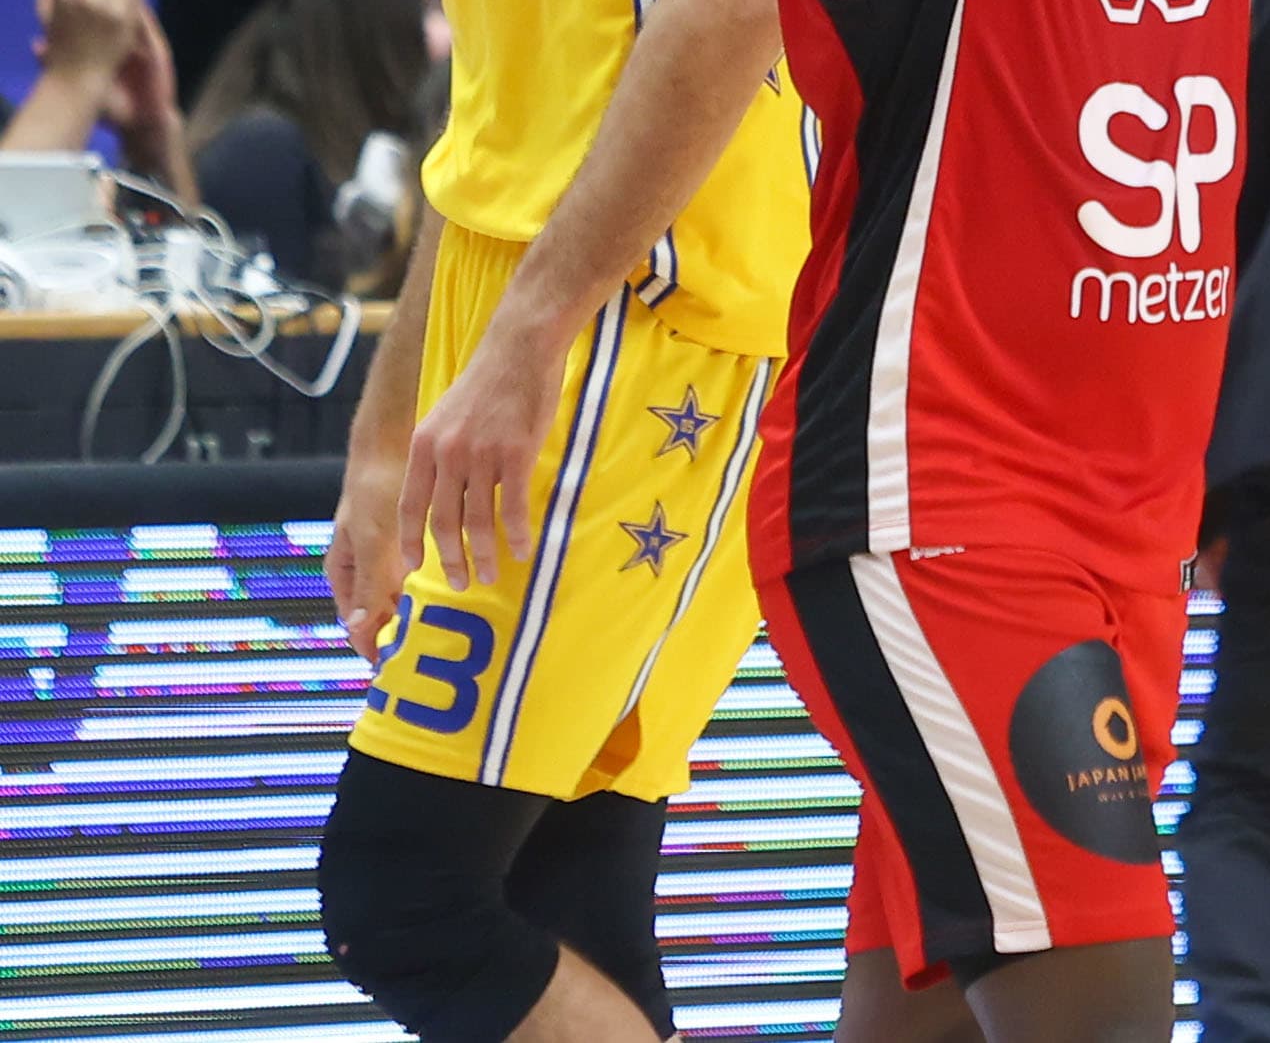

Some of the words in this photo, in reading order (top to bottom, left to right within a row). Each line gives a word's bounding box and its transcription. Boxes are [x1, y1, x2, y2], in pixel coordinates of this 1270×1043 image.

[1077, 75, 1237, 258] SP
[367, 594, 495, 734] 23
[1066, 764, 1129, 792] JAPAN
